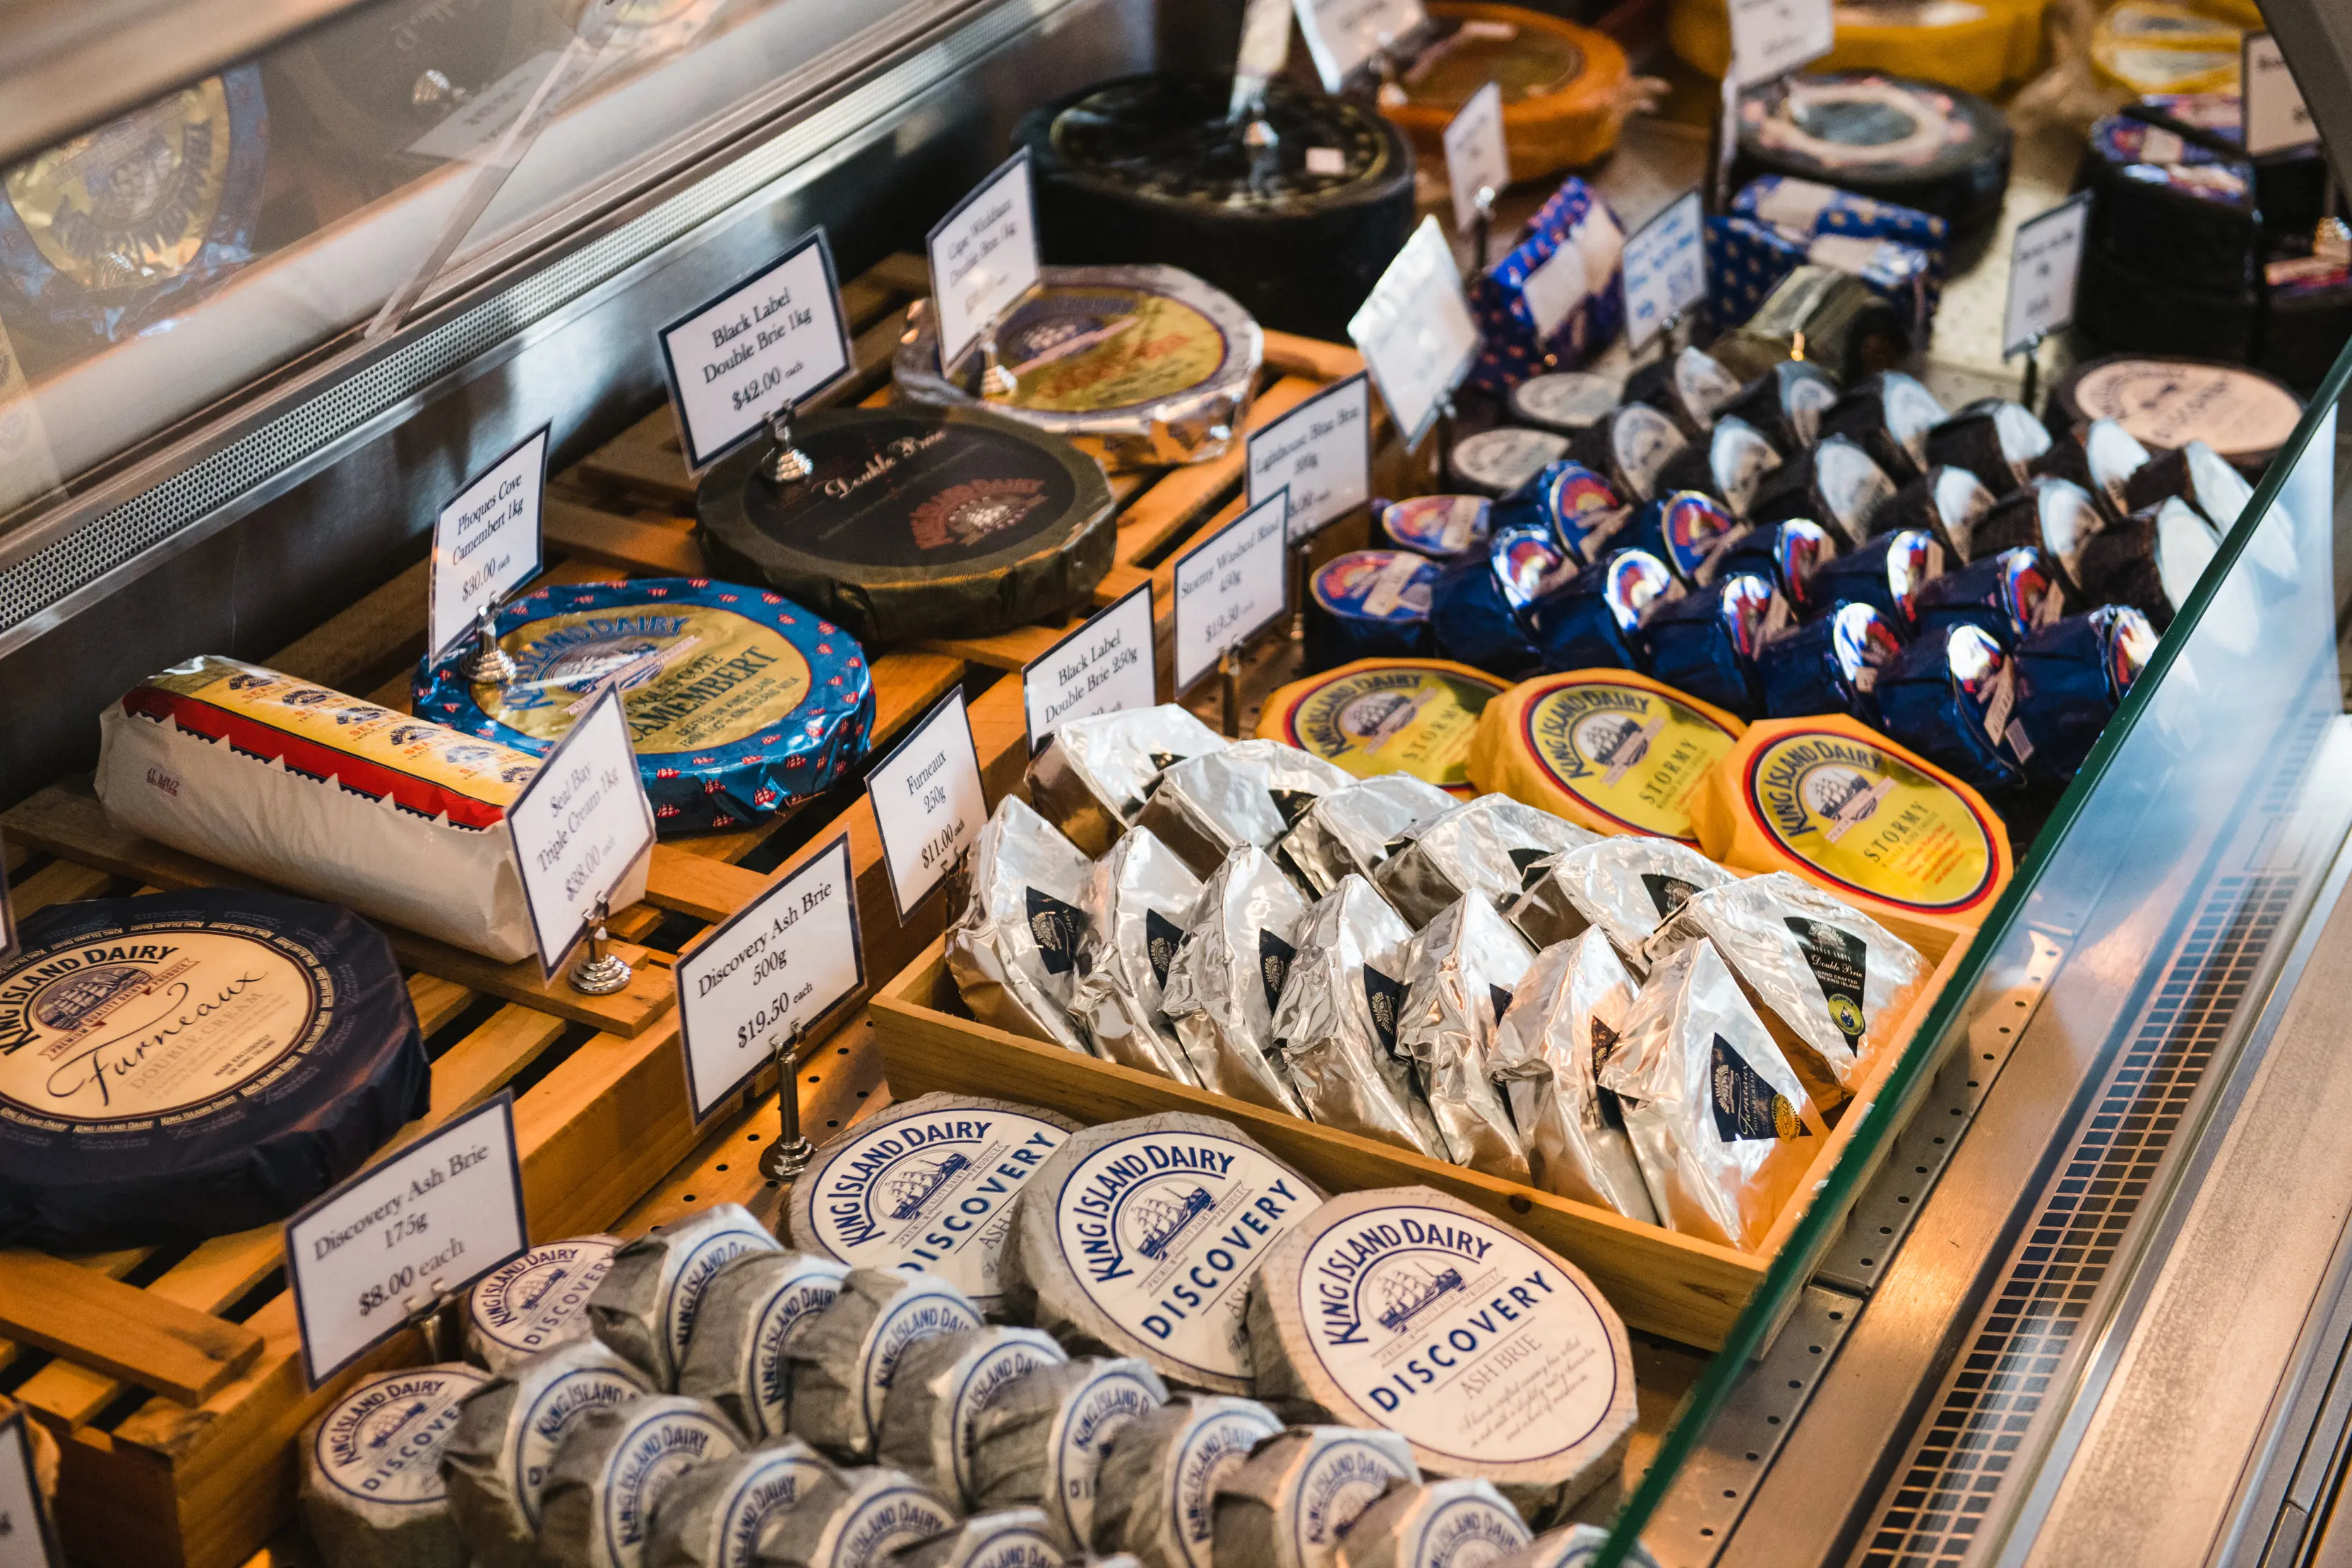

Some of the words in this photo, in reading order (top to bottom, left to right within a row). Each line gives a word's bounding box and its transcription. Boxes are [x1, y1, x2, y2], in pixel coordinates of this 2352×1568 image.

[711, 313, 752, 349] Black
[752, 287, 792, 323] Label
[701, 342, 756, 384] Double
[755, 323, 787, 352] Brie
[787, 306, 813, 332] 1kg
[732, 366, 782, 412] $42.00
[457, 493, 496, 537] Phoques
[499, 474, 522, 501] Cove
[453, 510, 506, 566] Camembert
[508, 498, 524, 522] 1kg
[462, 558, 496, 602] $30.00
[1058, 653, 1089, 687] Black
[1091, 628, 1121, 664] Label
[1044, 686, 1085, 724] Double
[1087, 666, 1110, 693] Brie
[1111, 645, 1139, 675] 250g
[1581, 690, 1651, 715] DAIRY
[1539, 694, 1585, 736] ISLAND
[569, 760, 594, 796] Bay
[906, 750, 947, 797] Furneaux
[1544, 738, 1595, 779] KING
[1639, 738, 1698, 806] STORMY
[1764, 746, 1818, 788] ISLAND
[1813, 739, 1884, 774] DAIRY
[923, 784, 947, 815] 250g
[1767, 791, 1818, 838] KING
[536, 827, 569, 874] Triple
[567, 790, 602, 837] Cream
[921, 822, 954, 870] $11.00
[953, 818, 965, 837] each
[1864, 800, 1930, 863] STORMY
[698, 930, 769, 1000] Discovery
[771, 907, 799, 941] Ash
[800, 880, 834, 915] Brie
[4, 957, 81, 1005] ISLAND
[81, 945, 179, 965] DAIRY
[752, 947, 788, 988] 500g
[1811, 954, 1841, 972] Double
[1840, 962, 1863, 978] Brie
[1817, 969, 1833, 978] HAND
[1834, 974, 1858, 986] CRAFTED
[49, 1026, 90, 1055] PREMIUM
[83, 998, 119, 1024] QUALITY
[119, 983, 143, 1003] DAIRY
[151, 960, 189, 987] PRODUCE
[737, 991, 789, 1049] $19.50
[792, 981, 813, 1005] each
[46, 970, 268, 1108] Furneaux
[899, 1120, 993, 1148] DAIRY
[1781, 1101, 1791, 1136] GOLD
[828, 1139, 905, 1202] ISLAND
[973, 1147, 1001, 1175] PRODUCE
[1142, 1144, 1236, 1175] DAIRY
[313, 1194, 403, 1262] Discovery
[407, 1167, 444, 1202] Ash
[447, 1144, 490, 1178] Brie
[1073, 1154, 1148, 1220] ISLAND
[1215, 1188, 1245, 1218] PRODUCE
[382, 1210, 429, 1250] 175g
[829, 1204, 886, 1248] KING
[1399, 1218, 1494, 1261] DAIRY
[525, 1247, 580, 1267] DAIRY
[1076, 1223, 1135, 1283] KING
[1140, 1178, 1299, 1339] DISCOVERY
[1318, 1223, 1402, 1283] ISLAND
[358, 1265, 415, 1318] $8.00
[419, 1237, 466, 1278] each
[481, 1262, 526, 1298] ISLAND
[523, 1250, 616, 1346] DISCOVERY
[799, 1286, 837, 1308] DAIR
[482, 1299, 519, 1328] KING
[1319, 1283, 1369, 1346] KING
[1368, 1269, 1556, 1413] DISCOVERY
[386, 1380, 446, 1399] DAIRY
[1460, 1363, 1500, 1401] ASH
[1492, 1332, 1544, 1370] BRIE
[330, 1392, 386, 1434] ISLAND
[330, 1434, 362, 1468] KING
[662, 1423, 710, 1456] DAIRY
